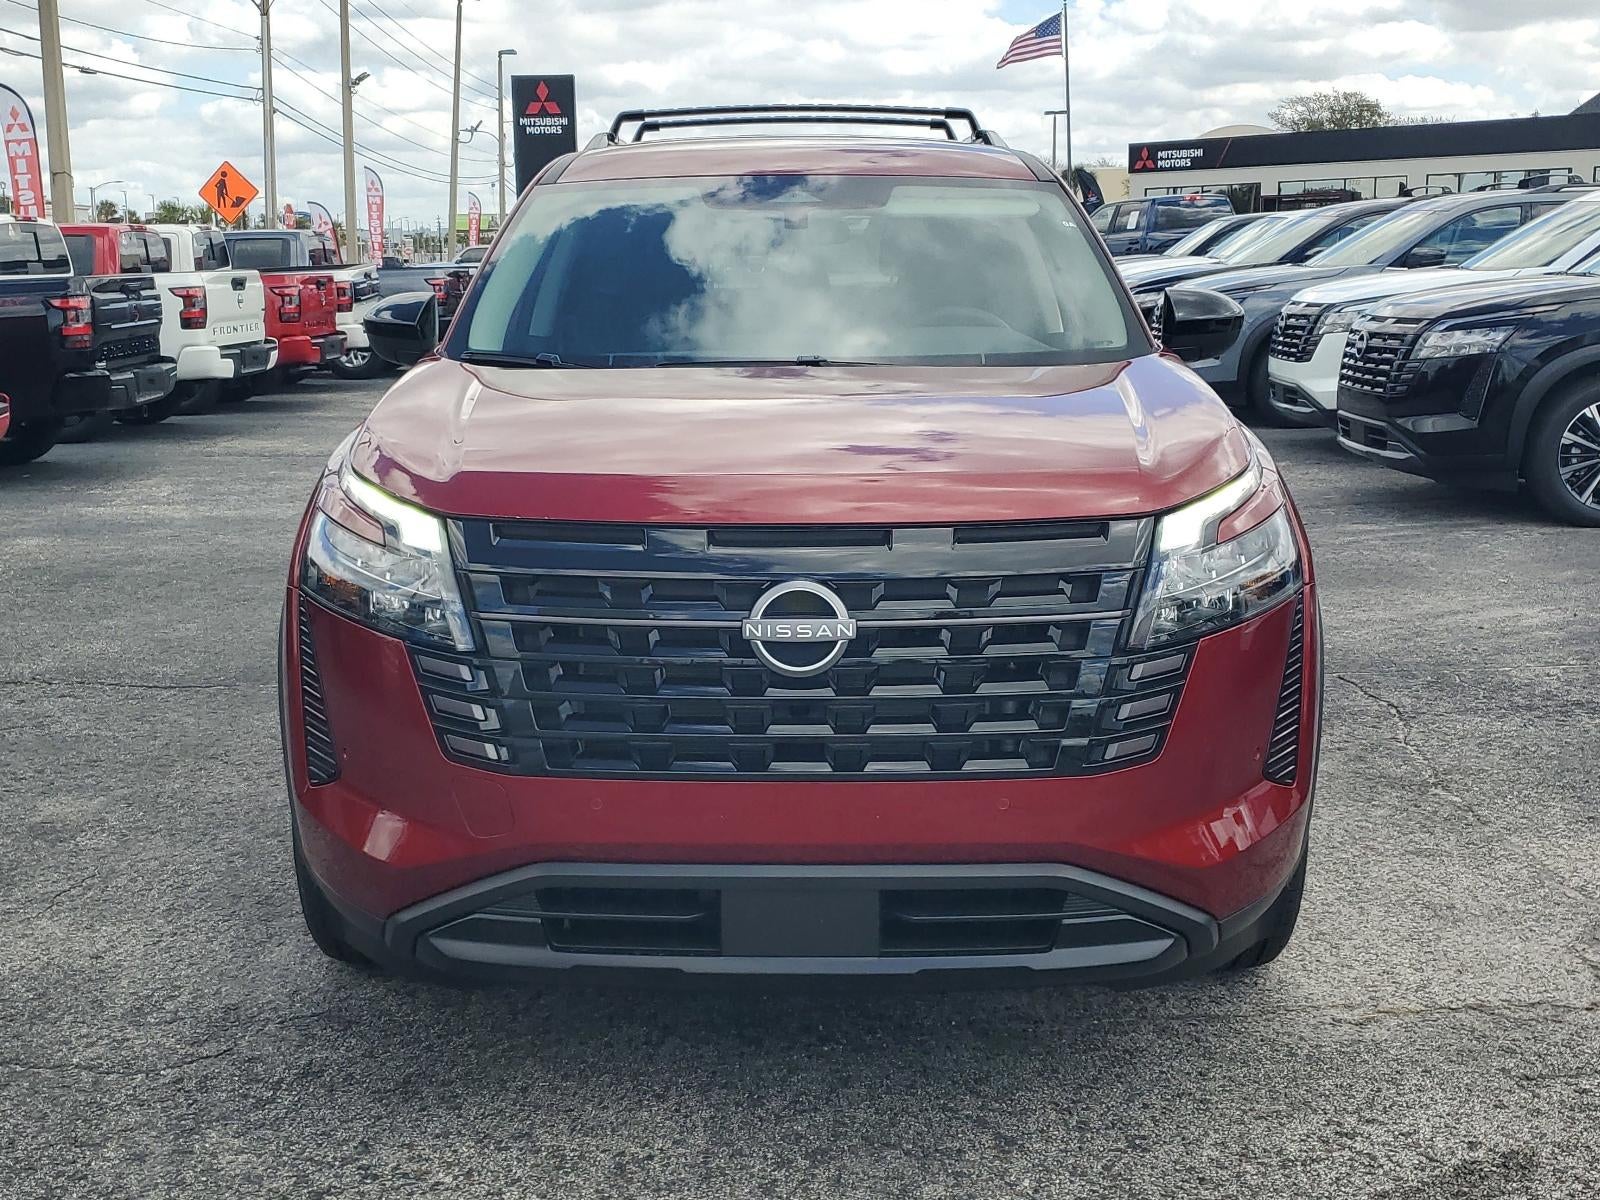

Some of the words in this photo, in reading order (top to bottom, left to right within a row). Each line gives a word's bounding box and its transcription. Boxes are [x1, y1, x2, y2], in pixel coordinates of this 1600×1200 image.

[519, 117, 568, 126] MITSUBISHI
[526, 126, 562, 135] MOTORS
[1157, 148, 1204, 160] MITSUBISHI
[1157, 158, 1192, 169] MOTORS
[212, 322, 260, 336] FRONTIER
[745, 623, 853, 638] NISSAN
